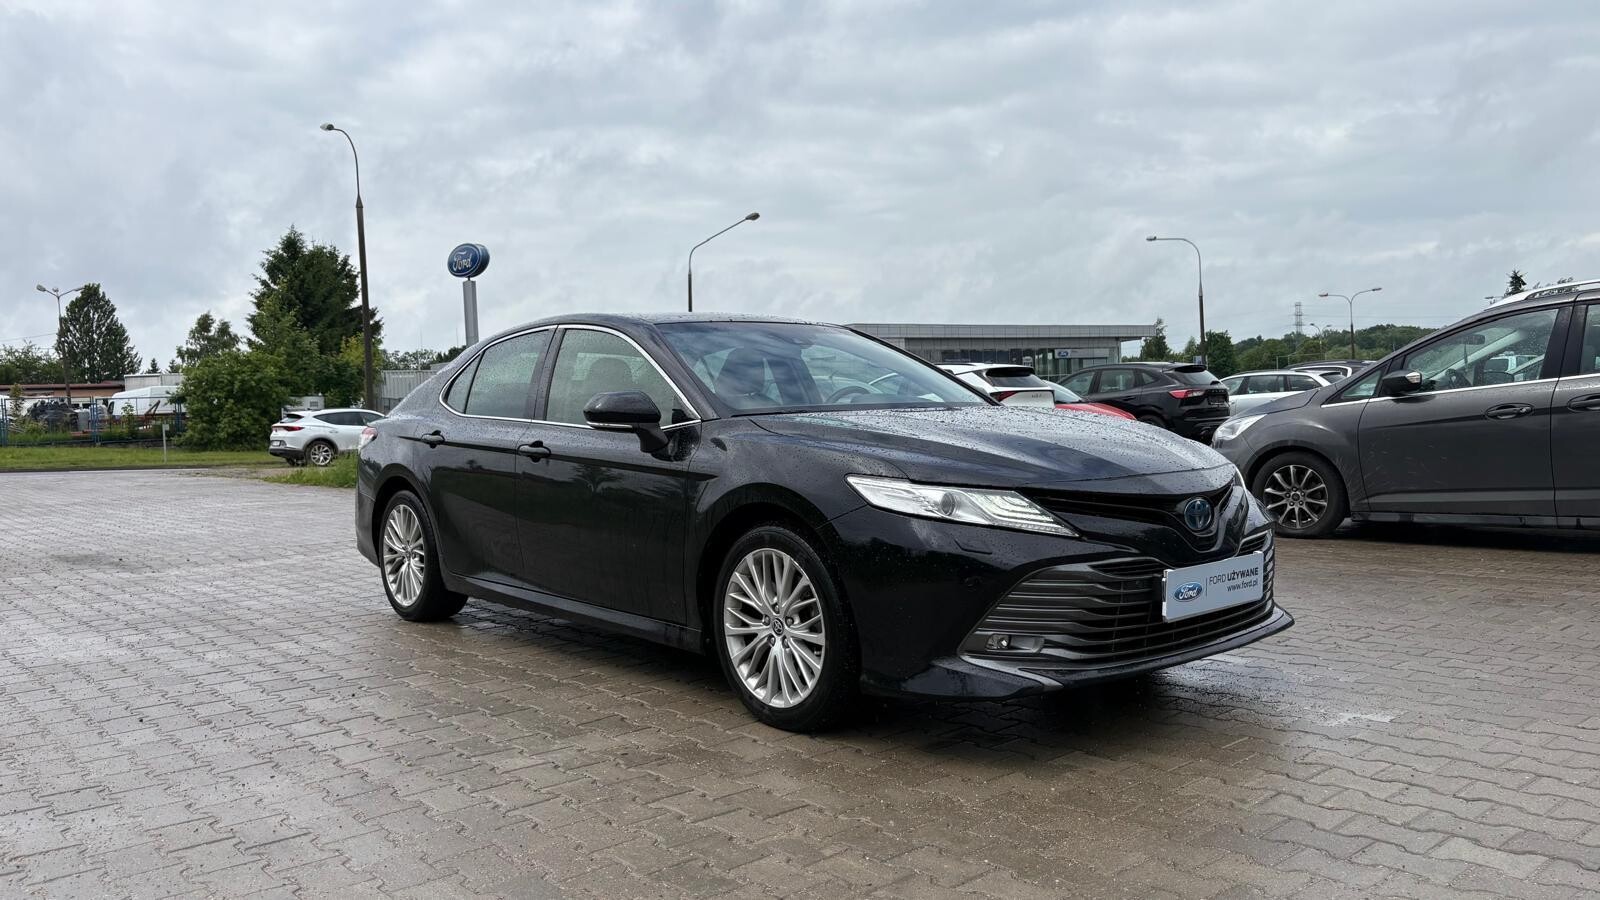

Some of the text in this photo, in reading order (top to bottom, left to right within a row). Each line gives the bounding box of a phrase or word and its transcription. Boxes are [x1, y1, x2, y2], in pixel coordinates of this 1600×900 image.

[453, 251, 472, 271] Ford
[1209, 567, 1259, 585] FORD UŻYWANE
[1178, 584, 1199, 600] Ford
[1226, 578, 1259, 592] www.ford.pl
